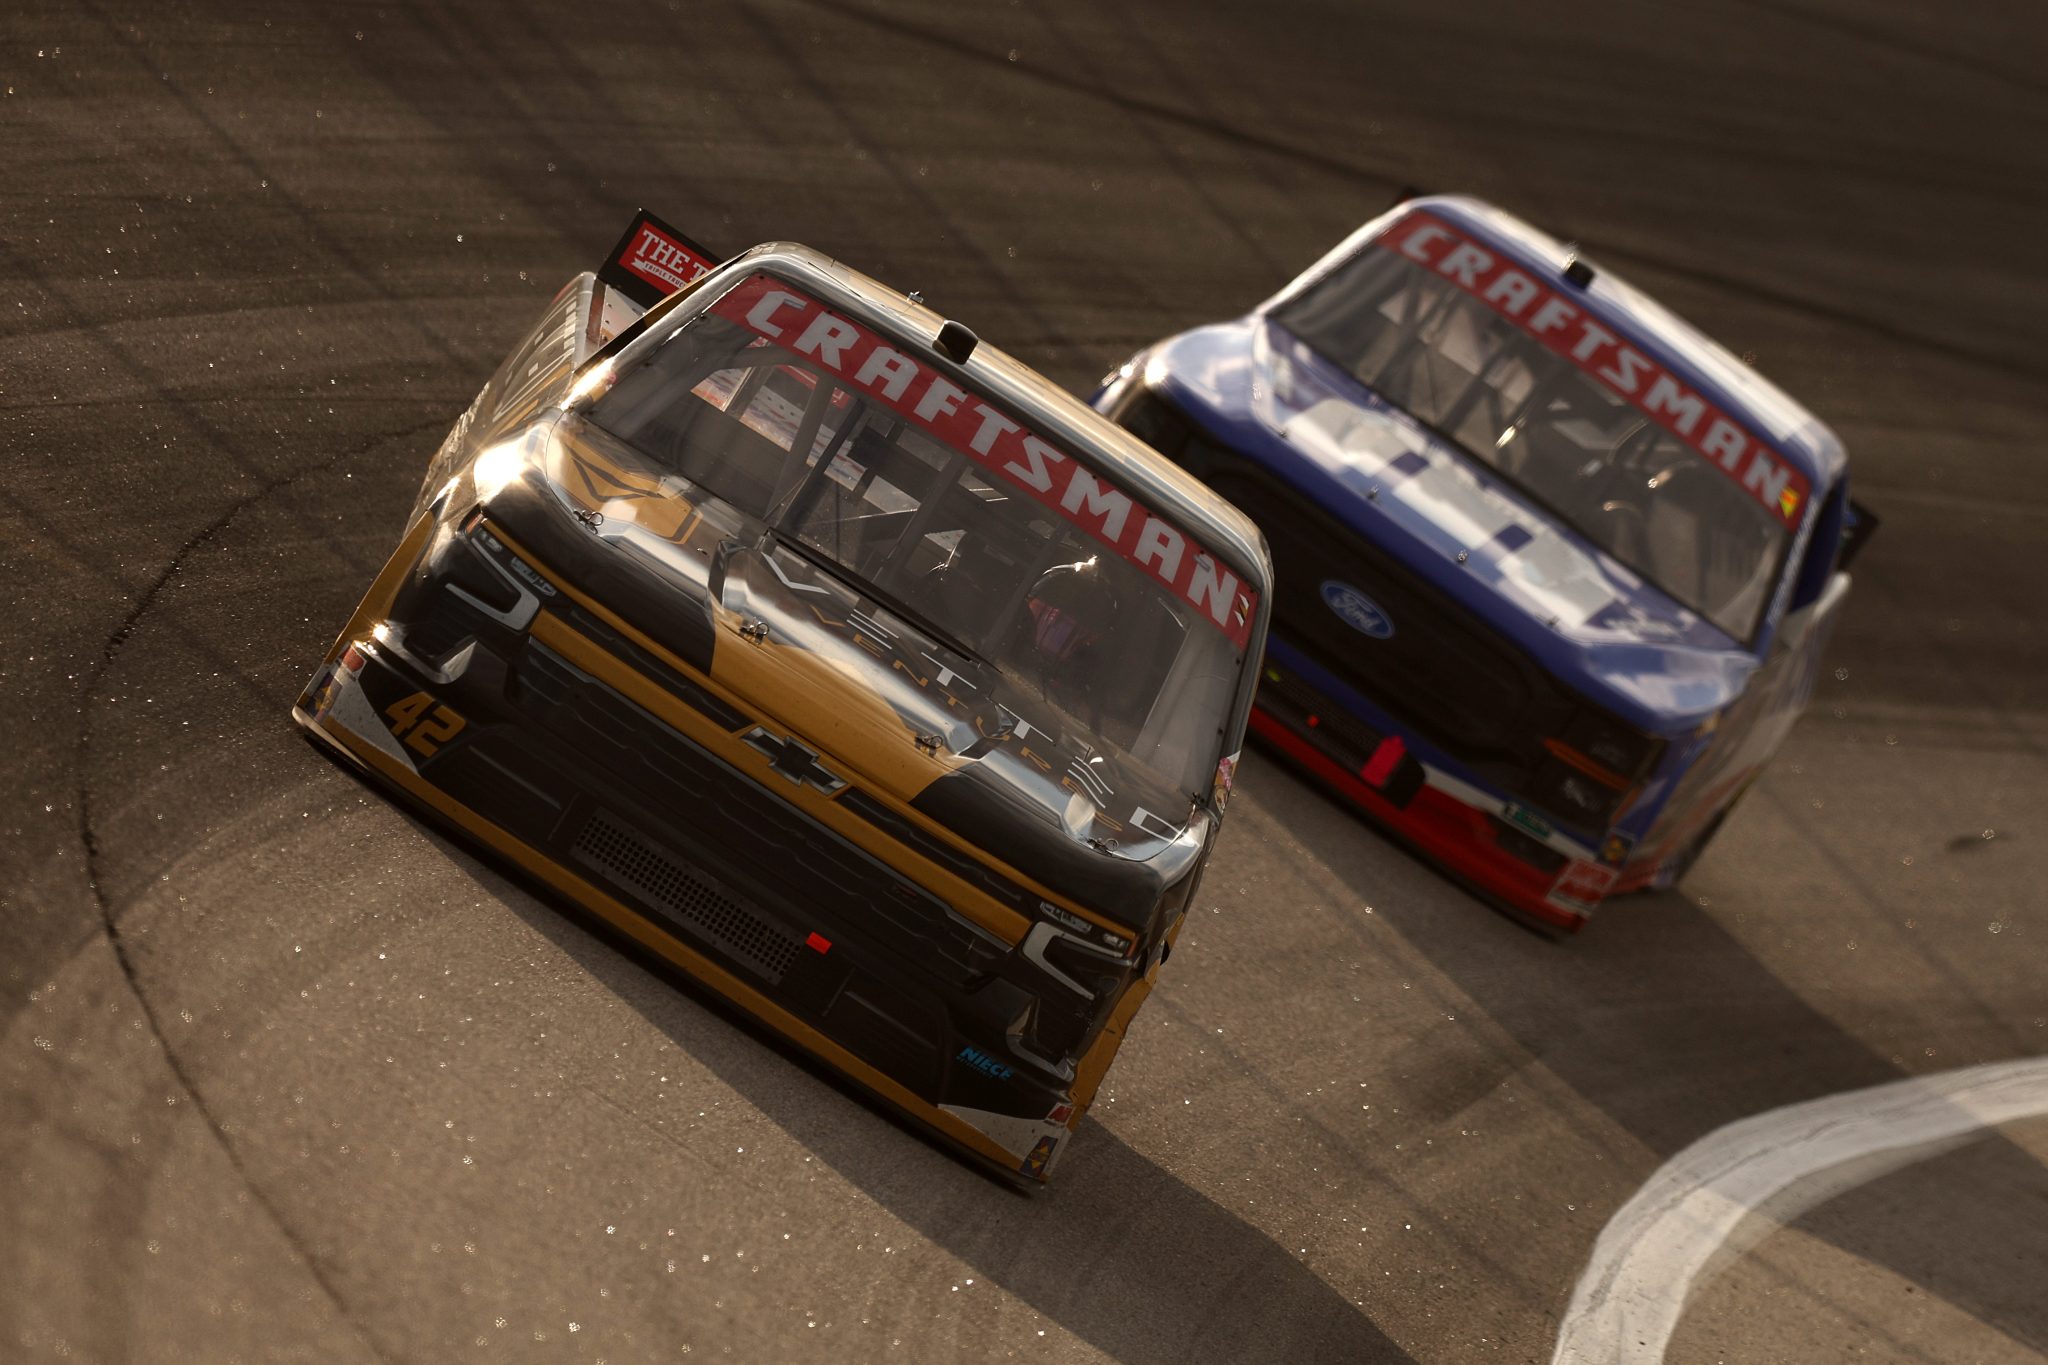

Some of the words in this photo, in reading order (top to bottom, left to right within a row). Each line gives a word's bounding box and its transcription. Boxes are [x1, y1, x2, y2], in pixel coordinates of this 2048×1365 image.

[635, 230, 691, 274] THE
[644, 263, 667, 279] TRIPLE
[667, 273, 687, 288] TRUC
[1402, 222, 1788, 510] CRAFTSMAN
[745, 290, 1239, 627] CRAFTSMAN
[1330, 591, 1382, 629] Ford
[385, 691, 467, 758] 42
[760, 552, 1188, 843] VETTED
[810, 604, 1123, 832] VENTURES
[958, 1046, 1014, 1081] NIECE
